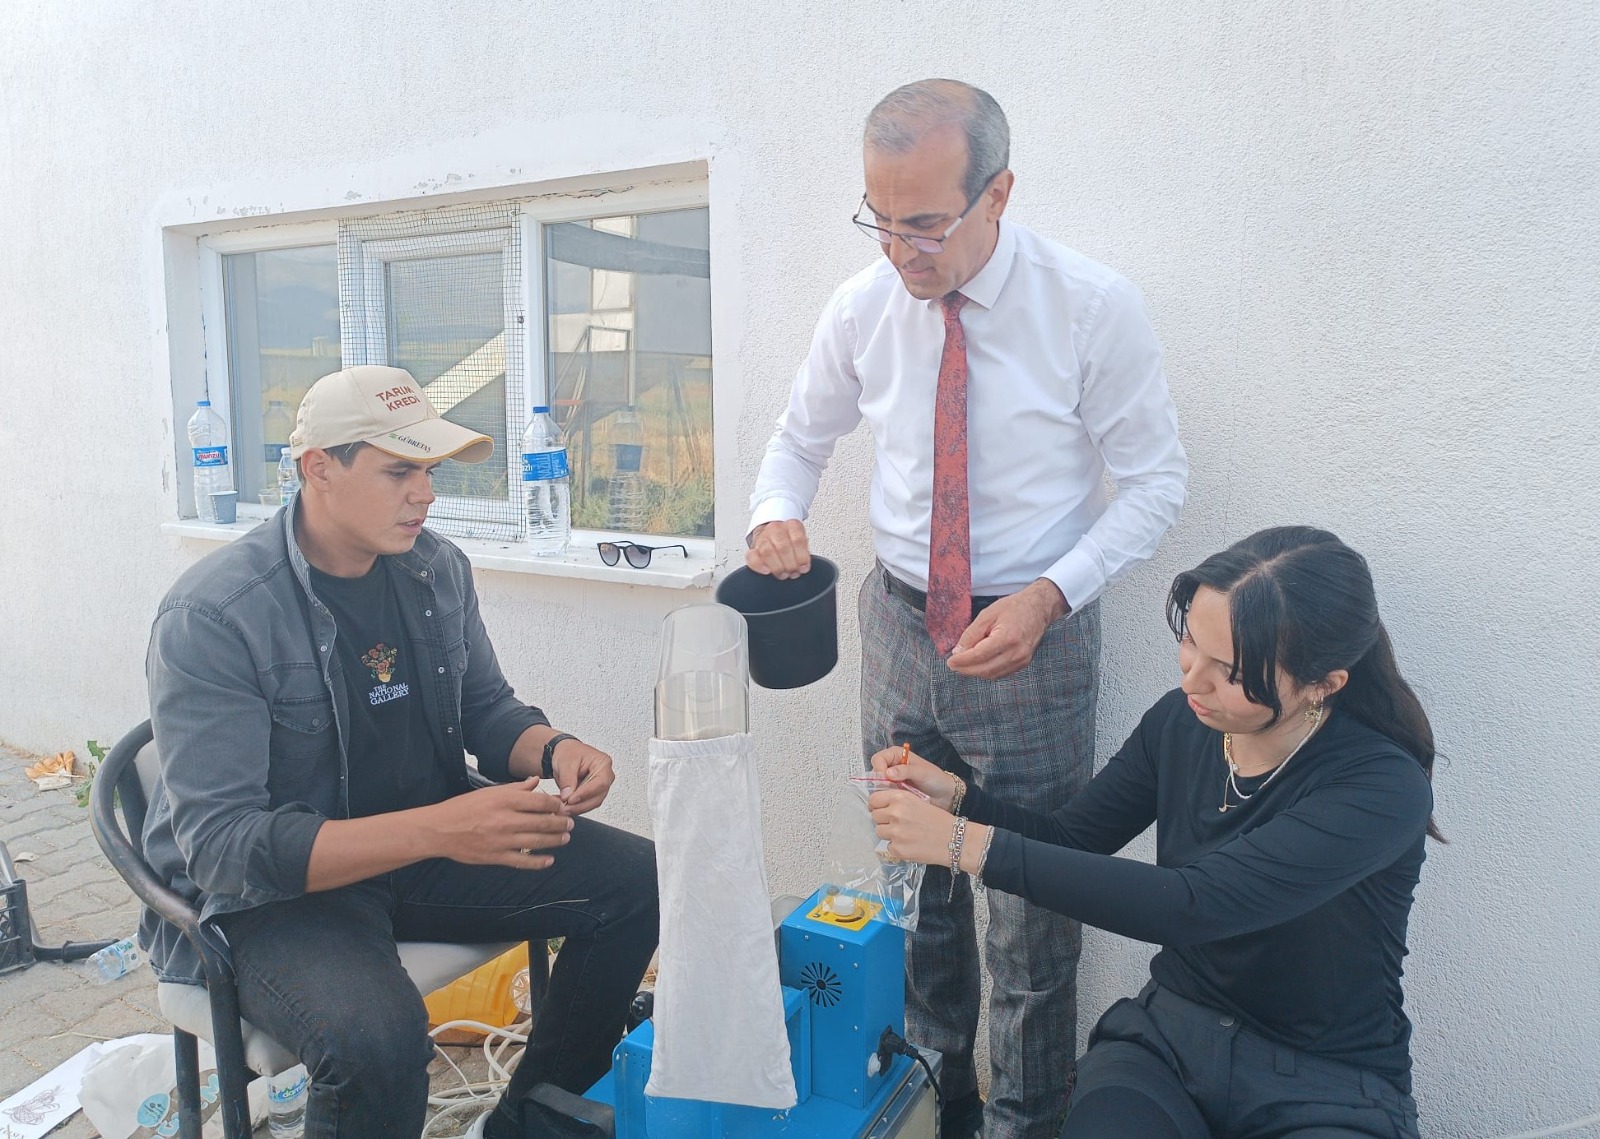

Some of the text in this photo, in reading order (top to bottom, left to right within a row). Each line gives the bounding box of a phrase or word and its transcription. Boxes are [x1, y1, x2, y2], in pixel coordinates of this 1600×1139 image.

[375, 386, 414, 402] TARIM
[369, 683, 409, 699] NATIONAL
[371, 687, 409, 705] GALLERY
[373, 684, 387, 692] THE
